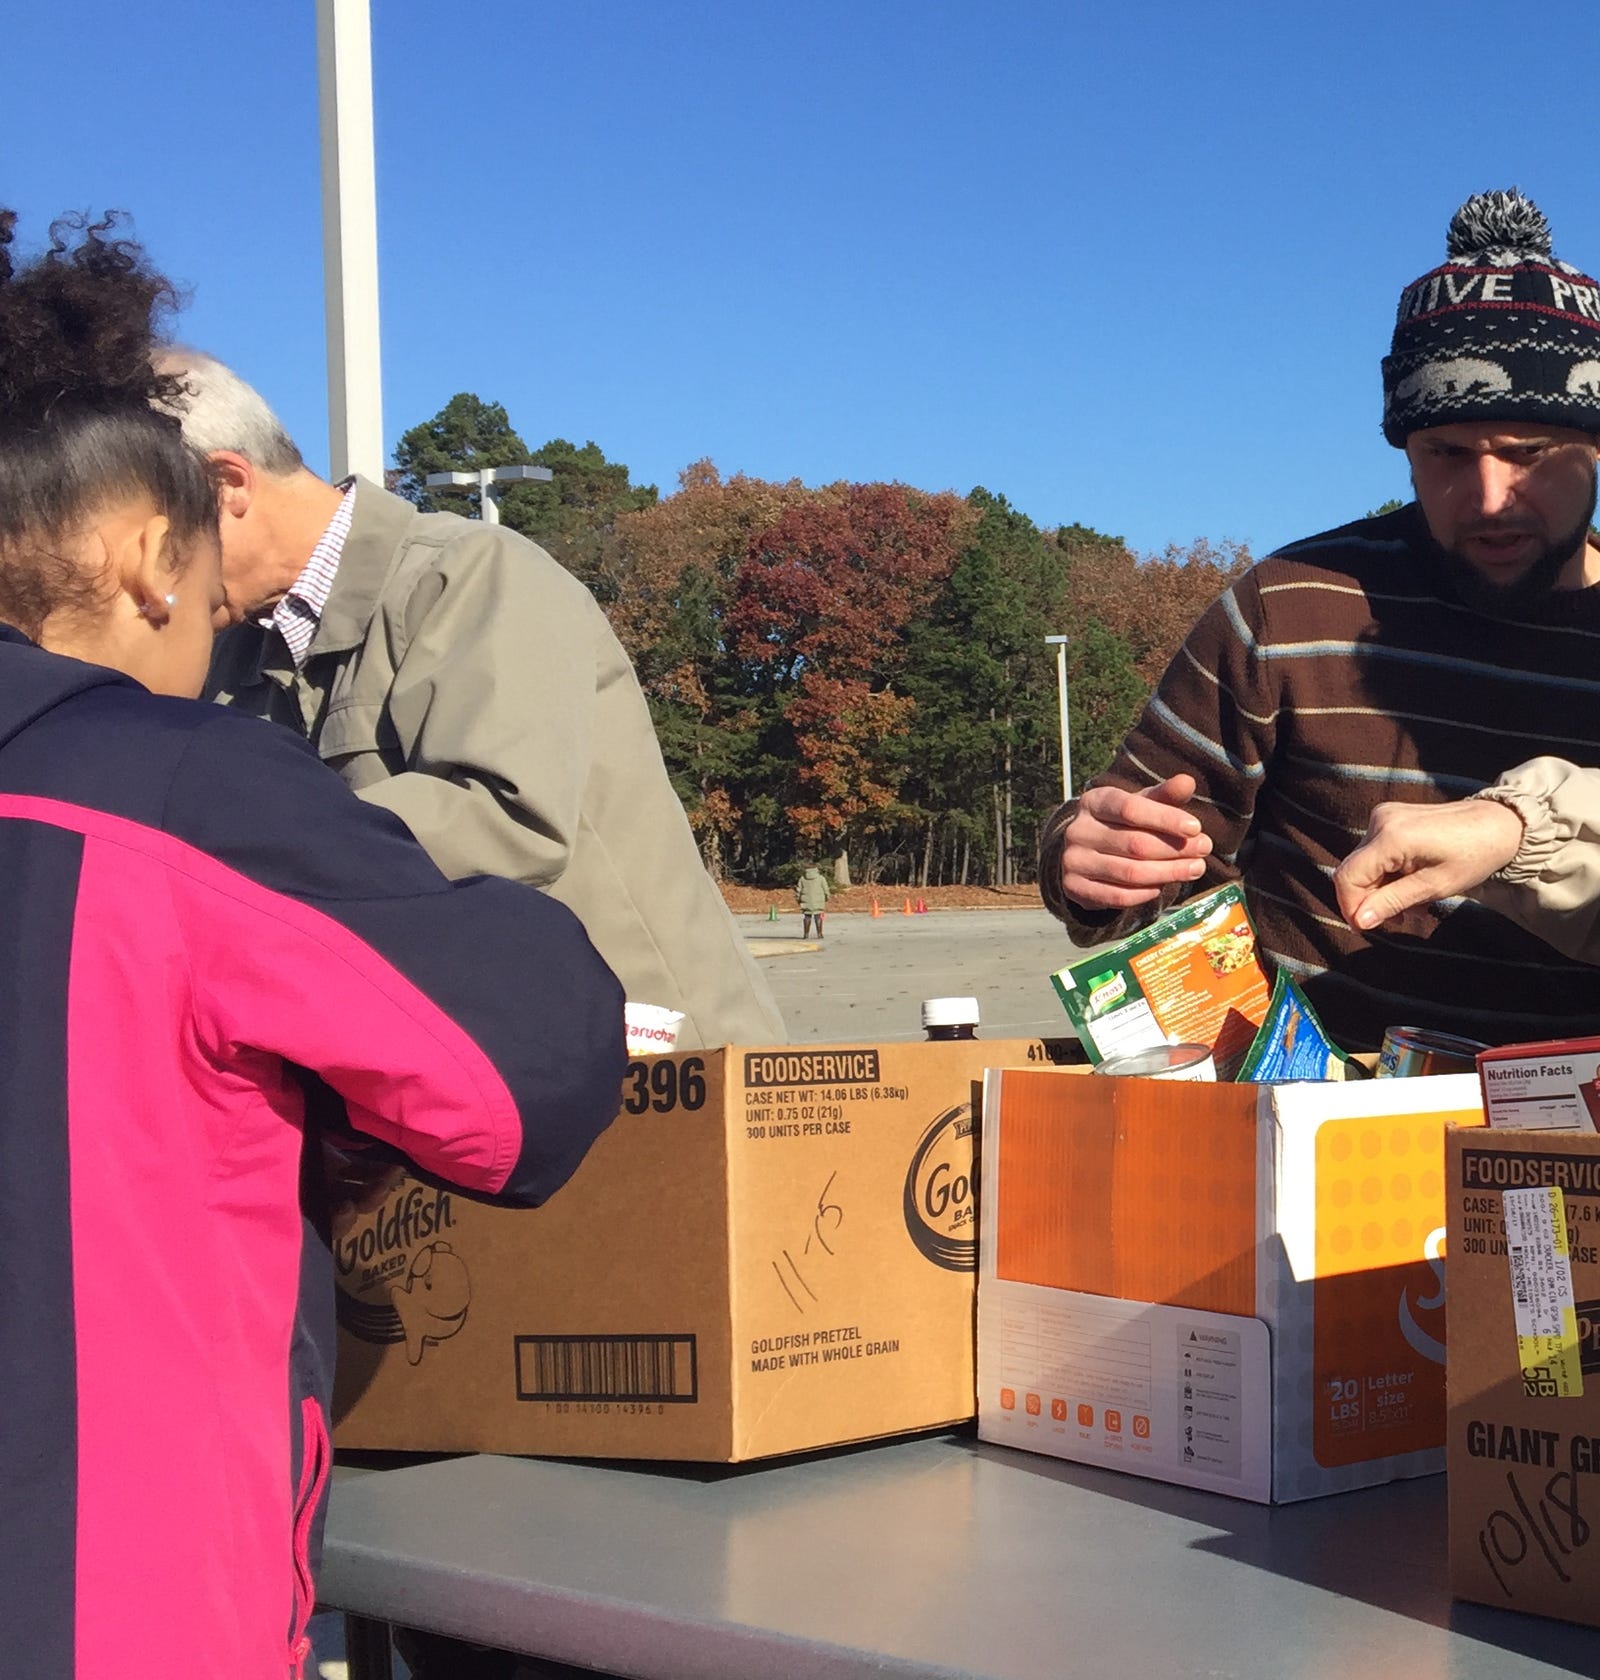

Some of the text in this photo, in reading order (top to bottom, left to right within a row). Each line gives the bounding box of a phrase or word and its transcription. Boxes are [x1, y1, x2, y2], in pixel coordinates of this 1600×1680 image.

[750, 1054, 876, 1083] FOODSERVICE
[1488, 1064, 1573, 1080] Nutrition Facts
[624, 1057, 706, 1116] 396
[745, 1086, 909, 1105] CASE NET WT: 14.06 LBS (6.38kg)
[746, 1104, 843, 1122] UNIT: 0.75 OZ (21g)
[746, 1121, 851, 1140] 300 UNITS PER CASE
[1464, 1197, 1499, 1215] CASE:
[1464, 1217, 1496, 1234] UNIT:
[1464, 1238, 1485, 1255] 300
[360, 1254, 407, 1281] BAKED
[751, 1326, 862, 1355] GOLDFISH PRETZEL
[751, 1339, 900, 1373] MADE WITH WHOLE GRAIN
[1330, 1378, 1359, 1402] 20
[1368, 1371, 1414, 1390] Letter
[1377, 1391, 1405, 1408] size
[1330, 1402, 1360, 1421] LBS
[1466, 1420, 1559, 1467] GIANT
[1478, 1471, 1590, 1598] 10/18
